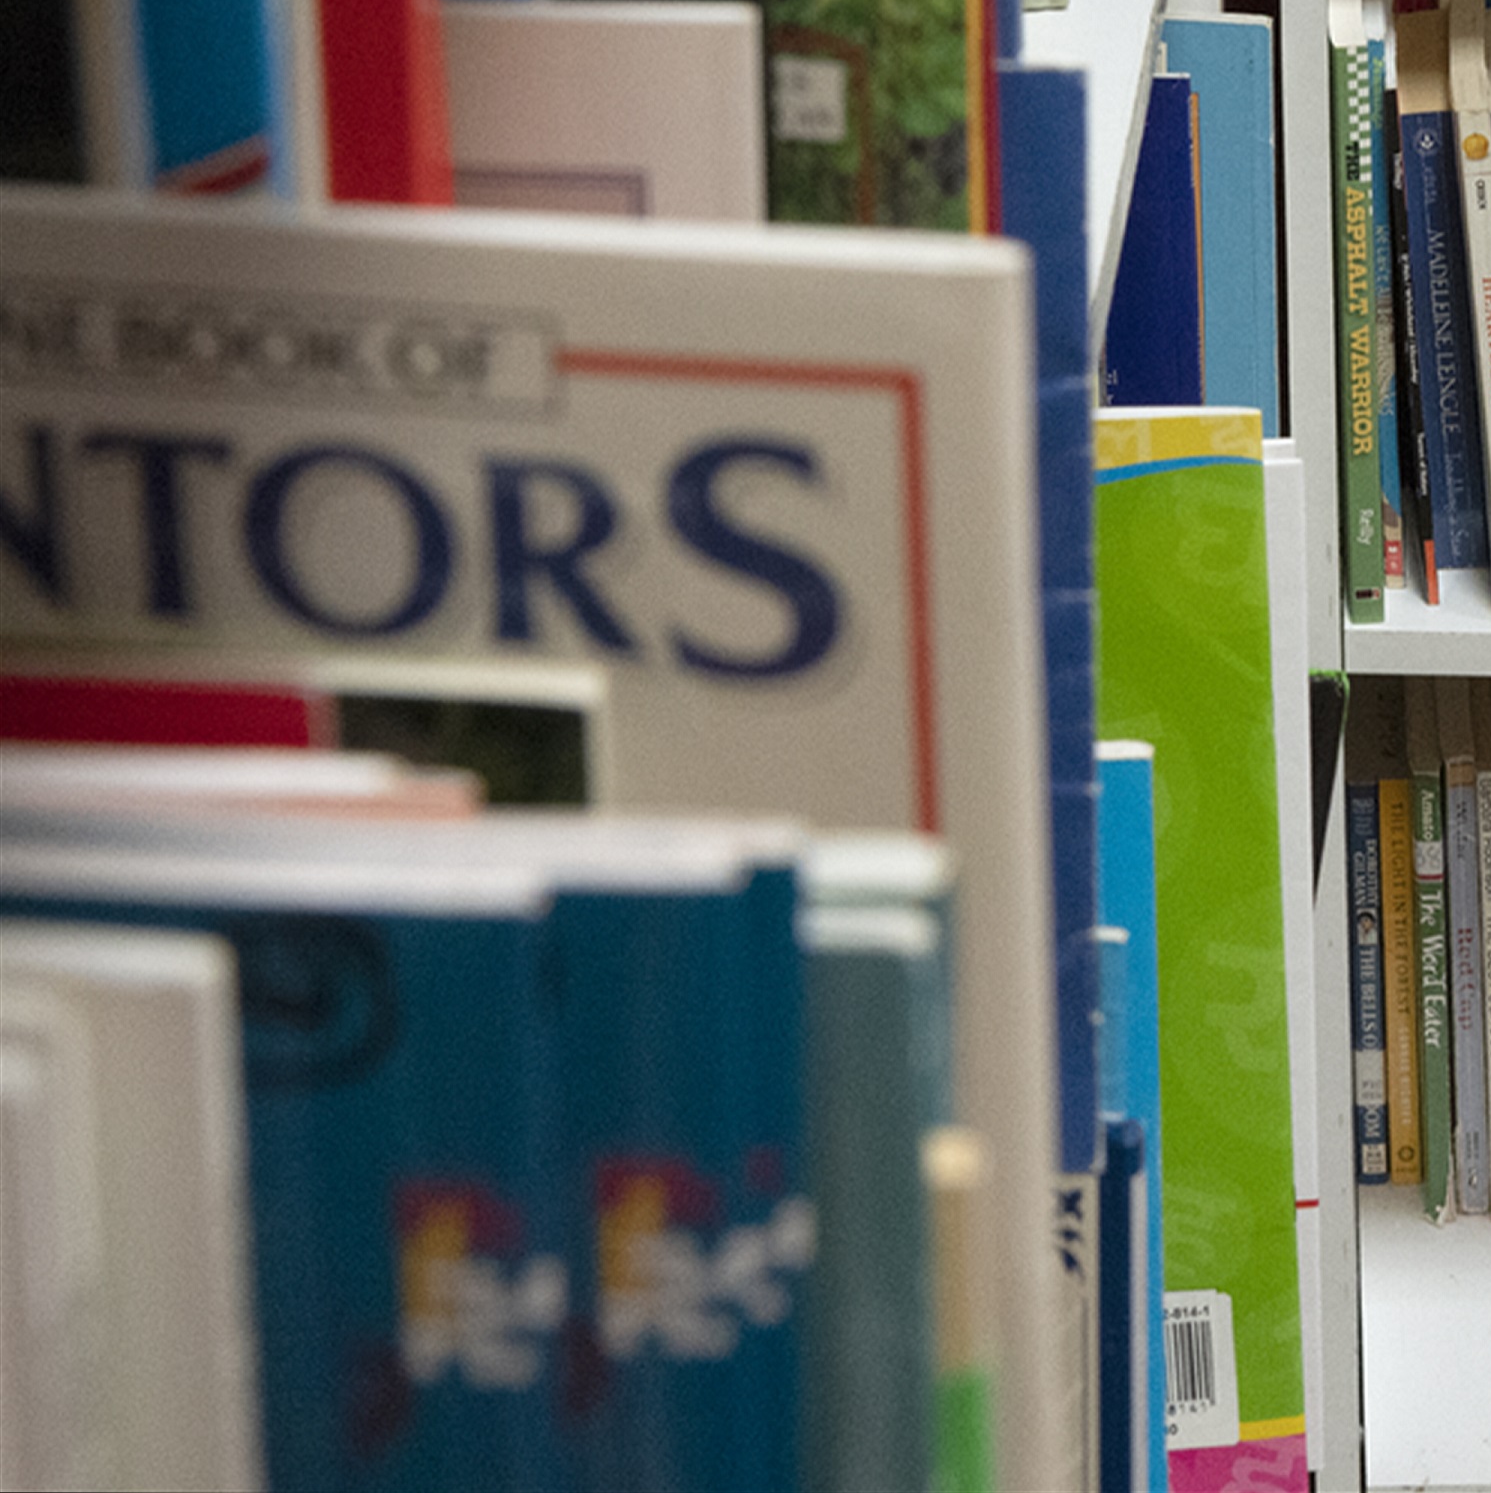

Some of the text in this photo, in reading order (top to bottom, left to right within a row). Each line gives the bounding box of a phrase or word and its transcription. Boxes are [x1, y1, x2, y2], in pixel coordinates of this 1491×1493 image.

[1345, 188, 1372, 454] ASPHALT WARRIOR
[1356, 509, 1374, 544] Reilly
[1420, 891, 1445, 1047] The Word Eater
